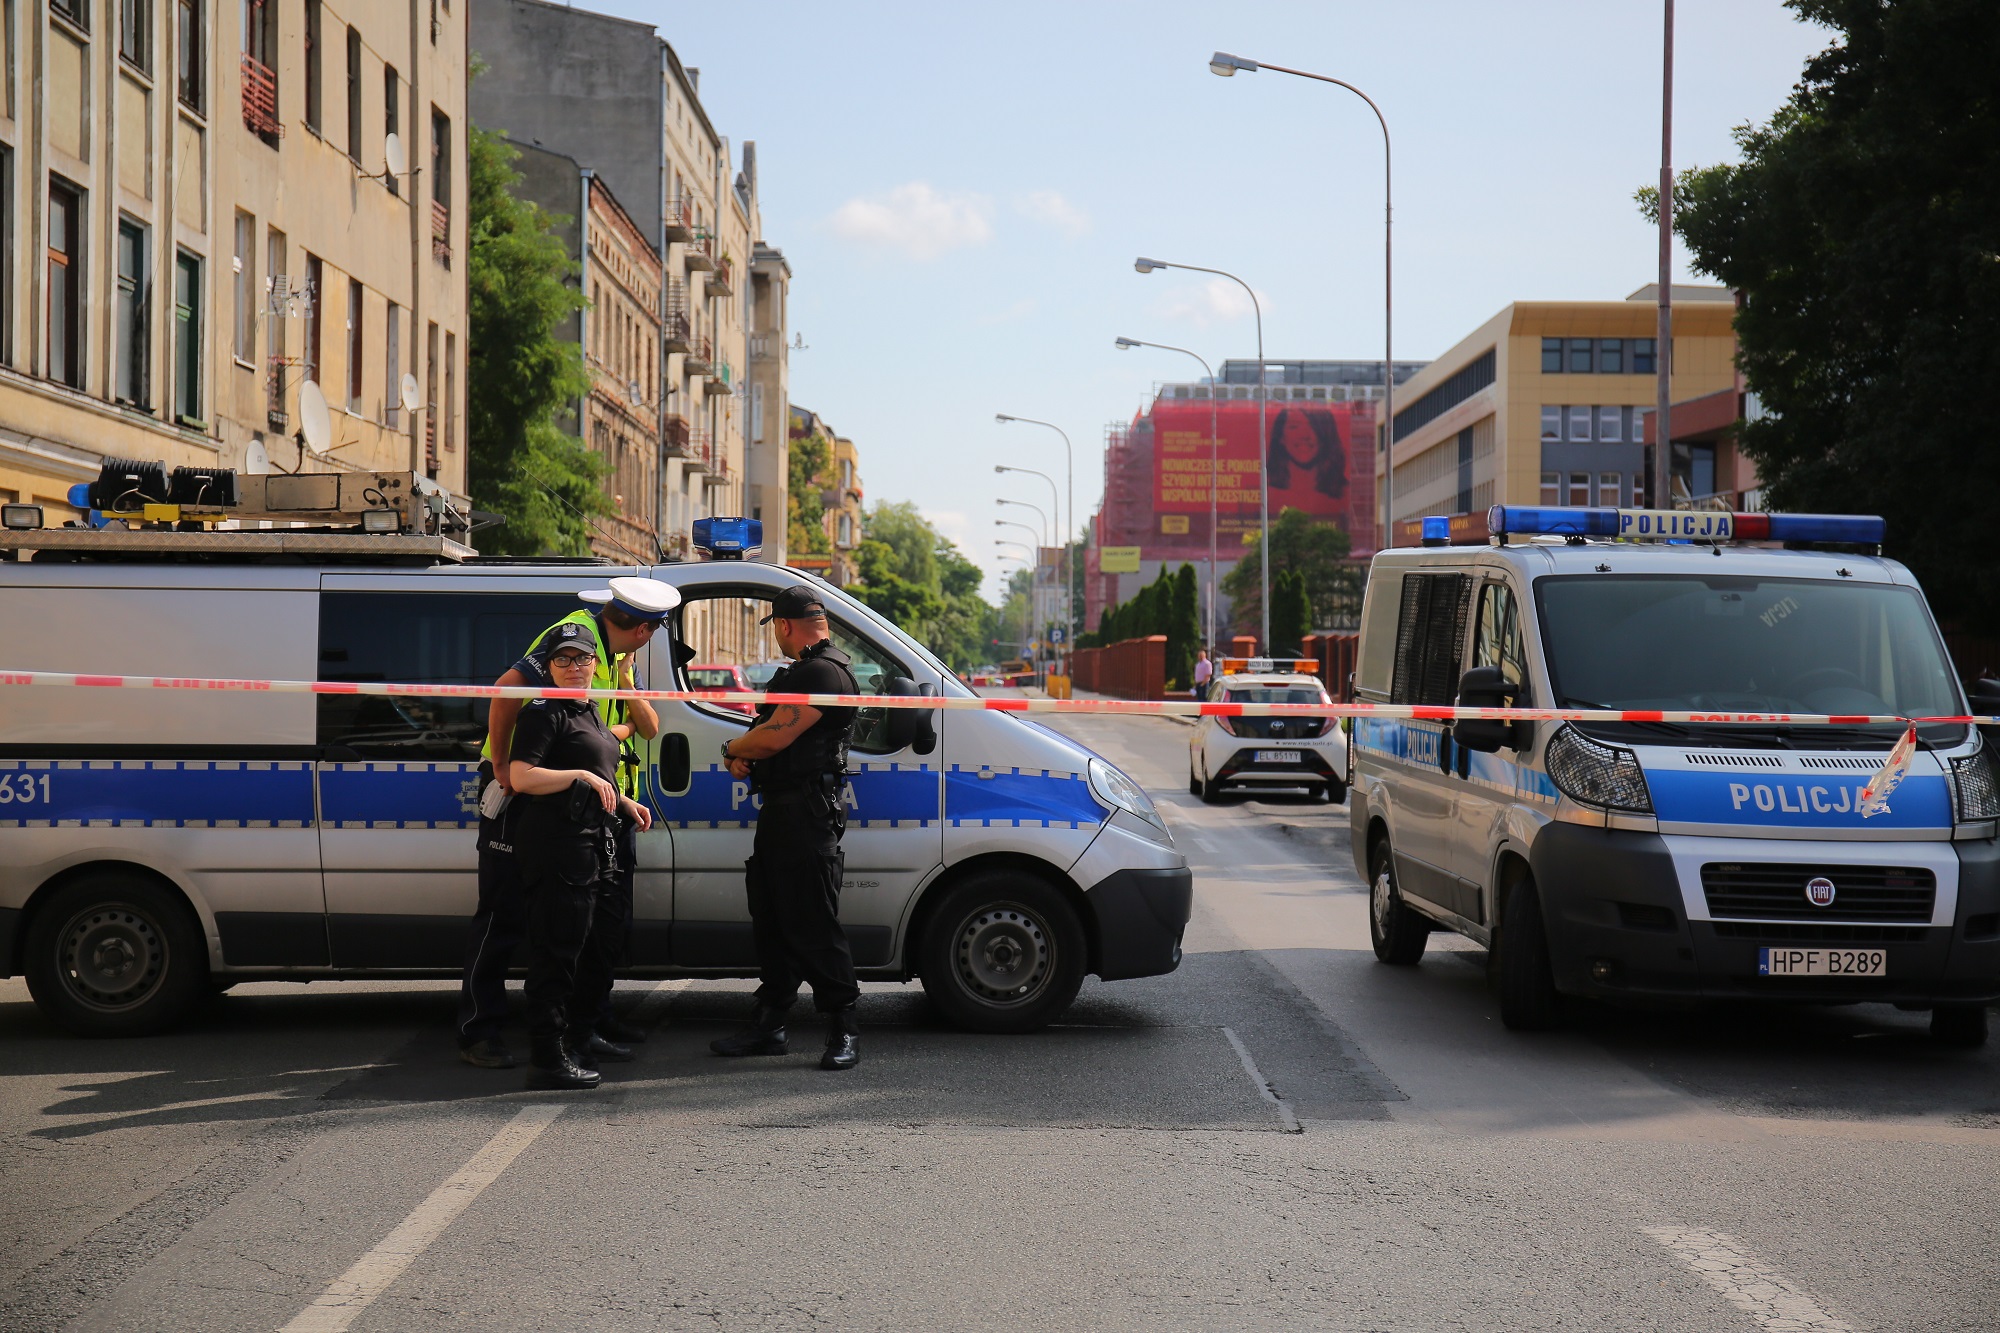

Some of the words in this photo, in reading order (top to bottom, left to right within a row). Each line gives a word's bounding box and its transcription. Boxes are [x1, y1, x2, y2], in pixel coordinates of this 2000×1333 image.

[1162, 474, 1196, 487] SZYBKI
[1208, 490, 1262, 503] PRZESTRZE
[1620, 514, 1730, 536] POLICJA
[1407, 729, 1438, 765] POLICJA
[1260, 752, 1271, 760] EL
[0, 774, 50, 803] 631
[489, 841, 513, 853] POLICJA
[1813, 886, 1830, 899] FIAT
[1773, 951, 1820, 973] HPF
[1829, 952, 1883, 974] B289
